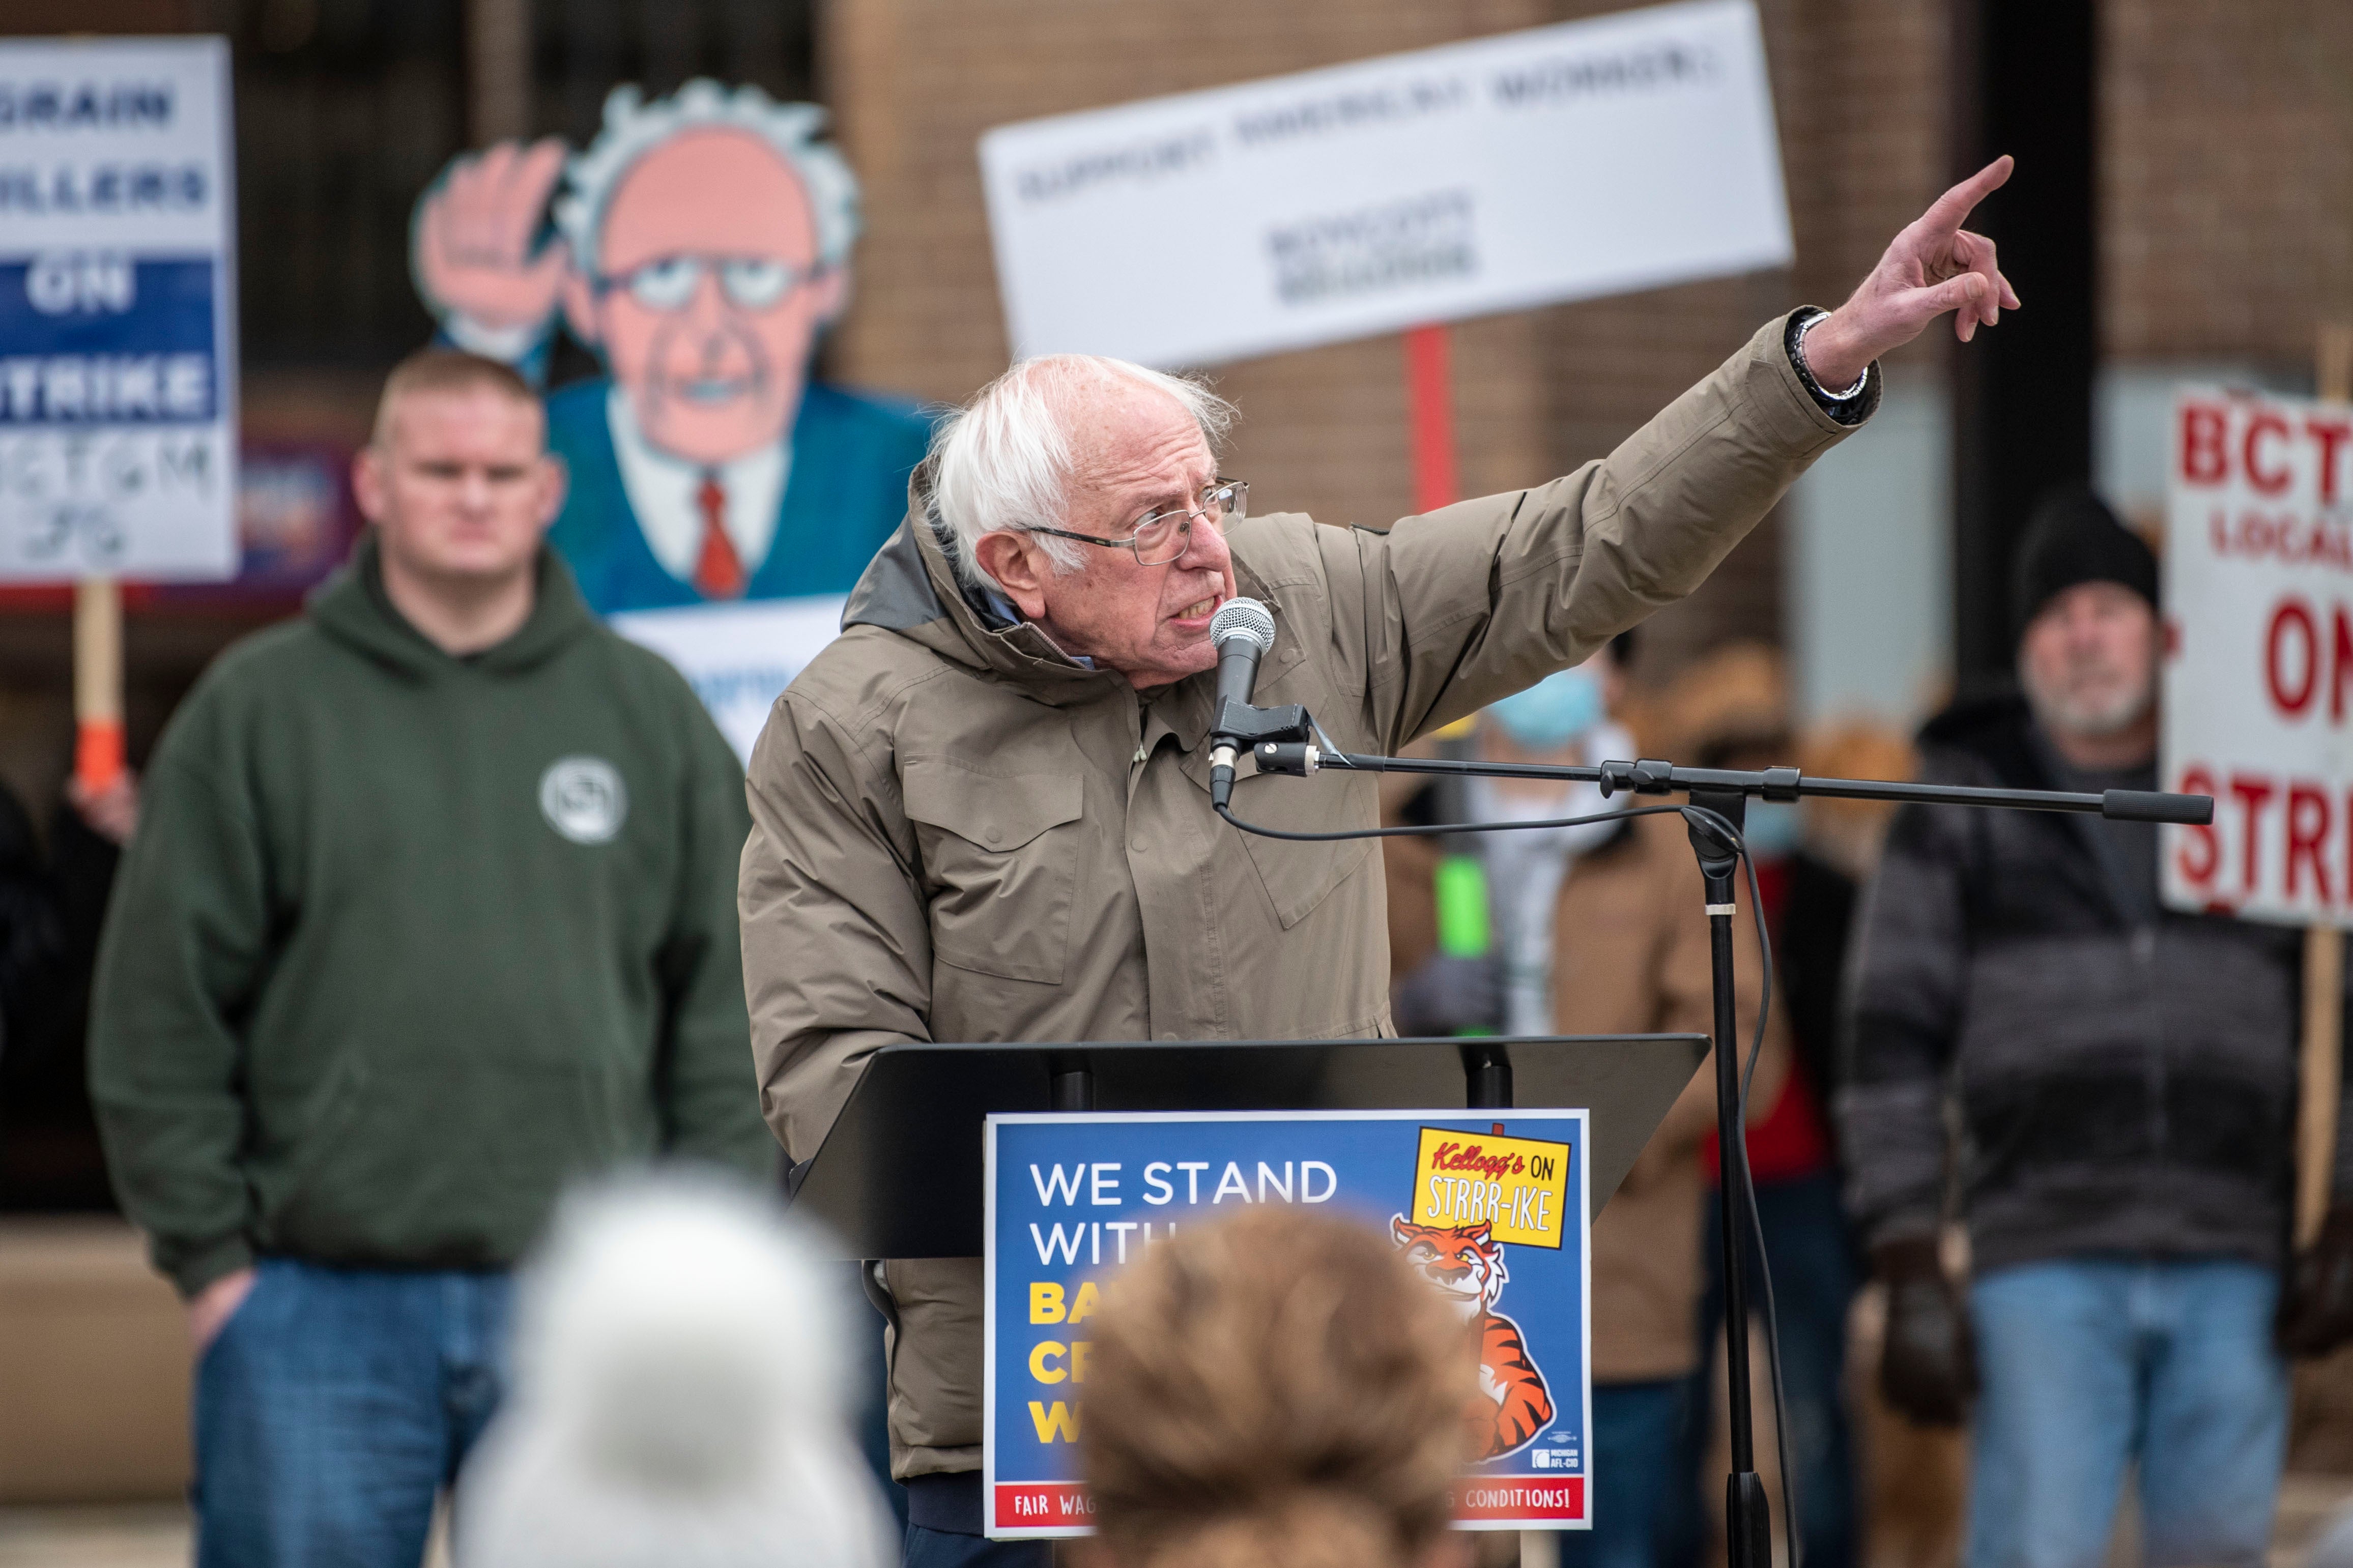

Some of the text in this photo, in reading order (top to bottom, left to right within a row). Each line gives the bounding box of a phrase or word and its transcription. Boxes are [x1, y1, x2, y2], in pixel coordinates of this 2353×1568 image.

[26, 253, 134, 313] ON
[1432, 1142, 1555, 1181] Kellogg's ON
[1030, 1161, 1337, 1206] WE STAND
[1427, 1175, 1553, 1232] STRRR-IKE
[1551, 1458, 1579, 1468] AFL-CIO
[1015, 1495, 1049, 1516] FAIR
[1466, 1488, 1569, 1508] CONDITIONS!
